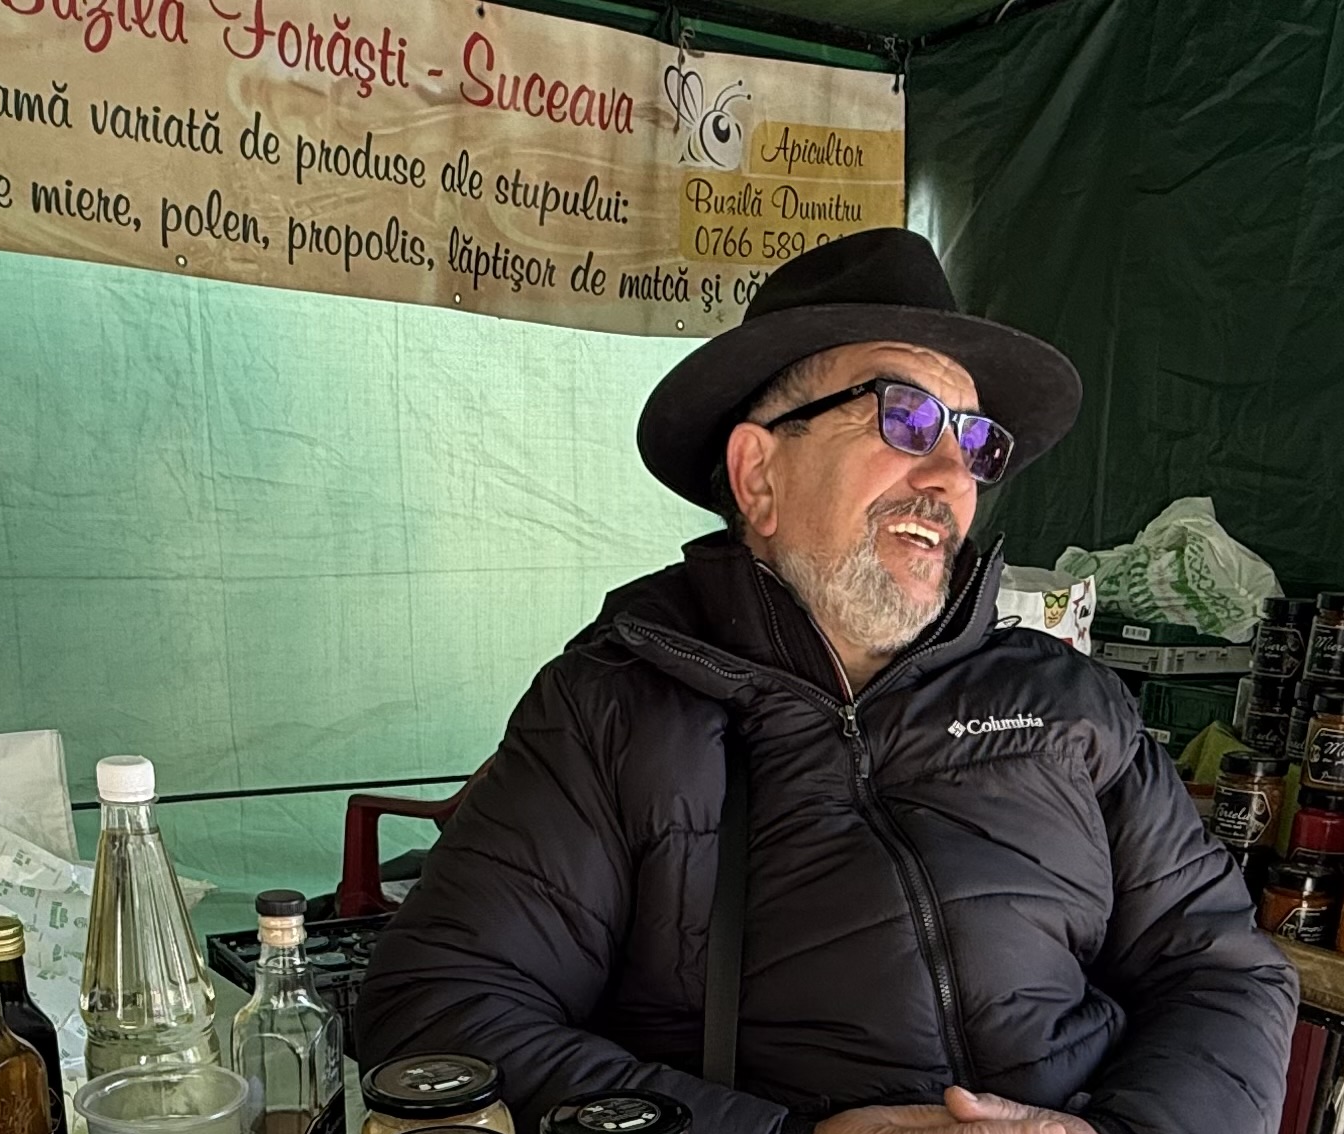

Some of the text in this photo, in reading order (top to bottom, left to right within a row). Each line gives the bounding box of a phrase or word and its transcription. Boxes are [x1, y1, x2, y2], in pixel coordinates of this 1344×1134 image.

[460, 30, 634, 135] Suceava
[90, 100, 223, 154] variată
[240, 112, 280, 164] de
[297, 133, 426, 188] produse
[441, 150, 483, 199] ale
[495, 176, 629, 226] stupului:
[760, 126, 864, 168] Apicultor
[685, 177, 863, 223] Buzilă Dumitru
[31, 178, 141, 231] miere,
[162, 190, 270, 250] polen,
[288, 215, 435, 272] propolis,
[571, 252, 606, 296] de
[619, 266, 690, 302] matcă
[695, 225, 752, 258] 0766
[762, 230, 806, 260] 589
[967, 714, 1044, 735] Columbia
